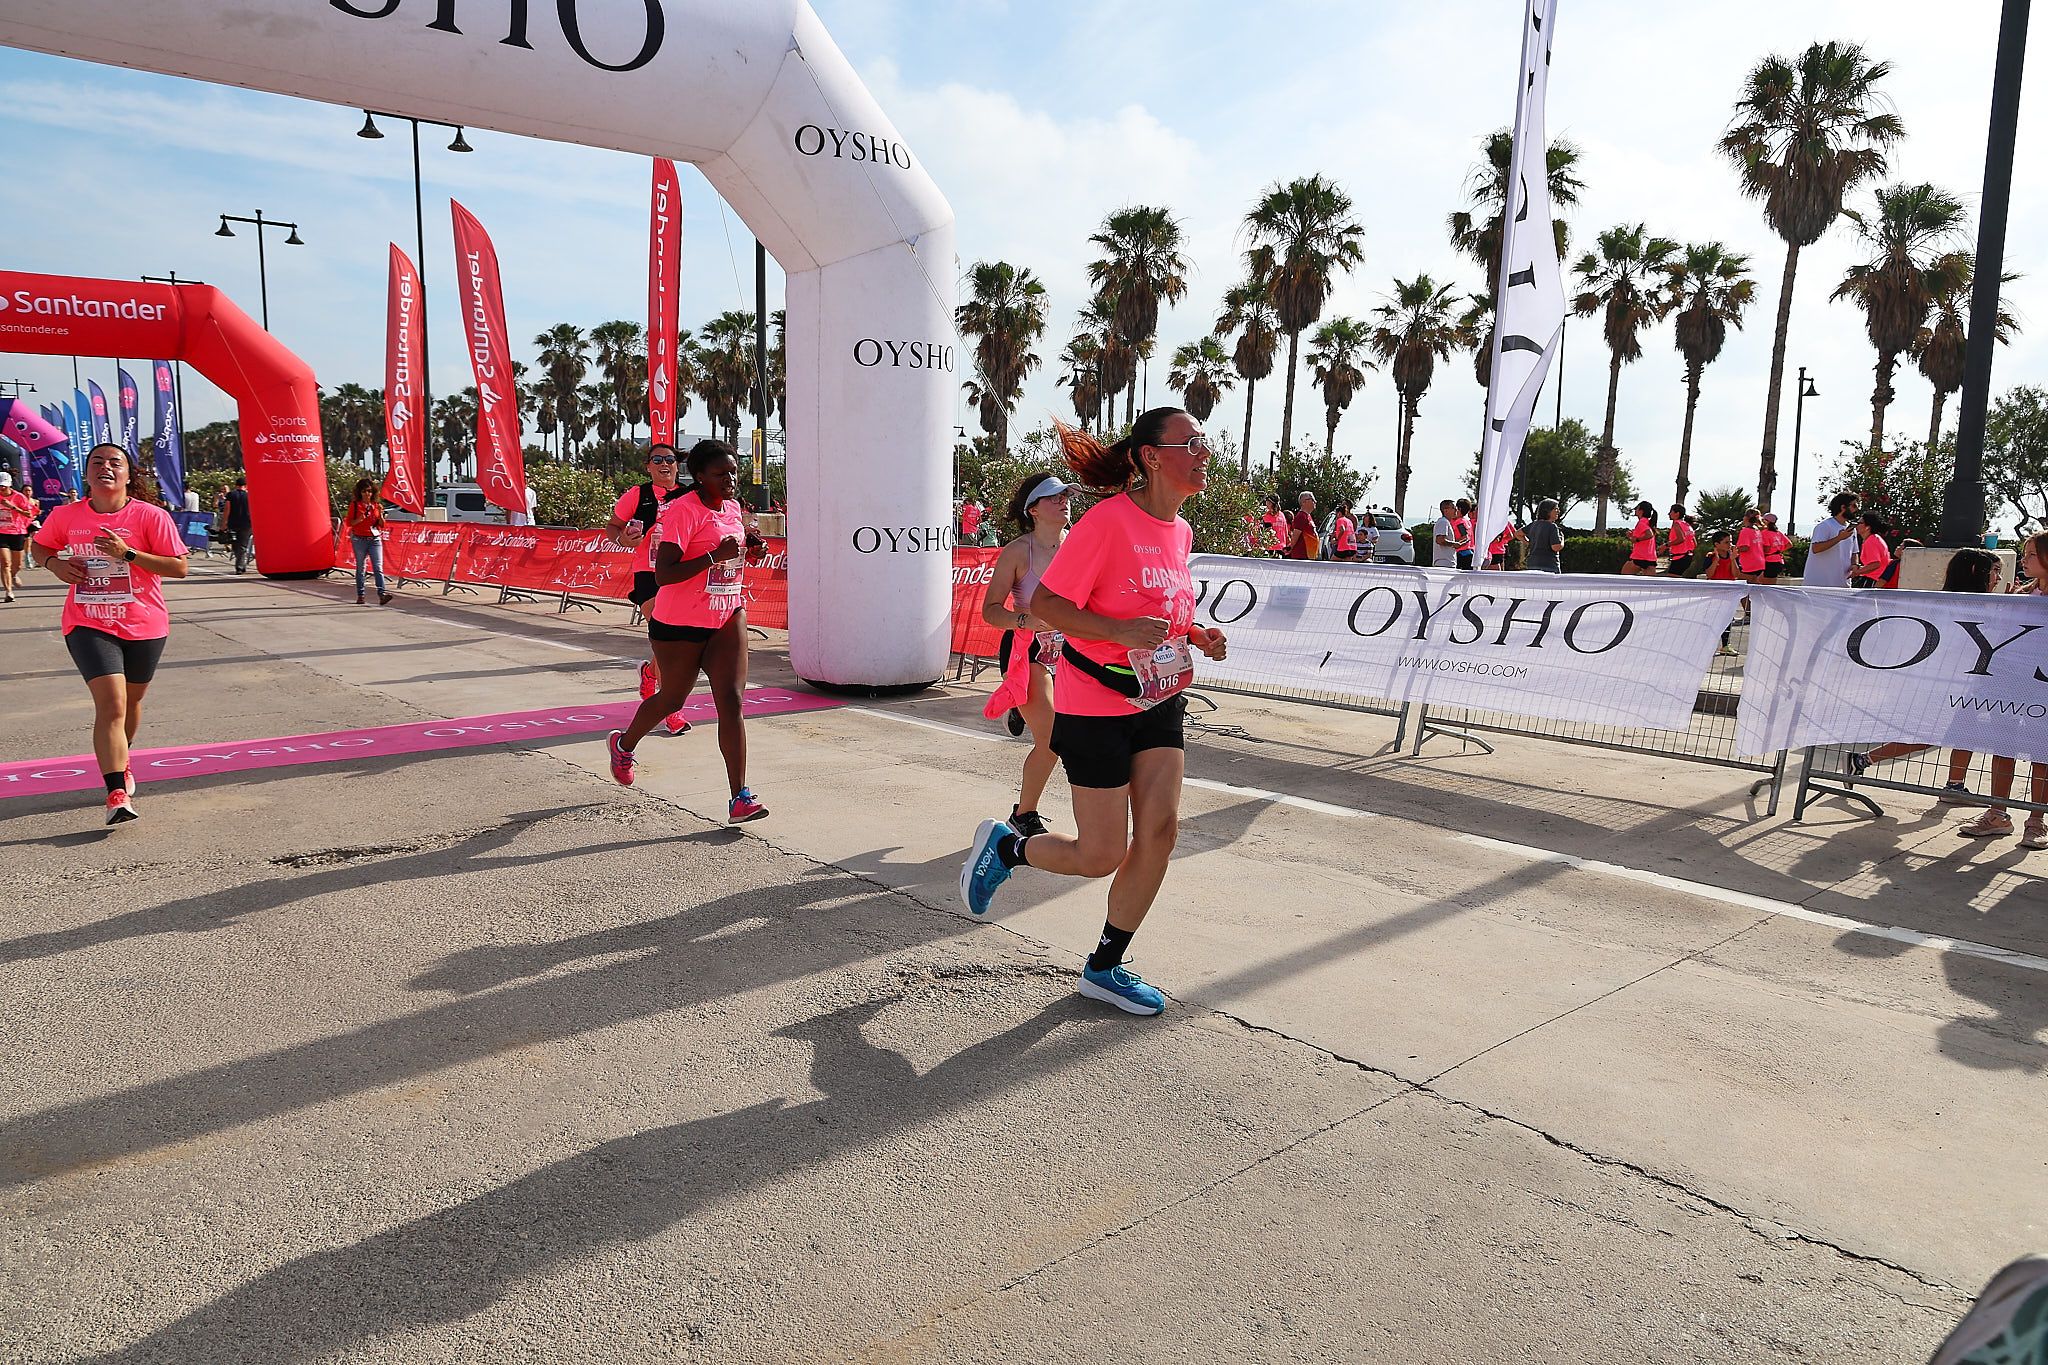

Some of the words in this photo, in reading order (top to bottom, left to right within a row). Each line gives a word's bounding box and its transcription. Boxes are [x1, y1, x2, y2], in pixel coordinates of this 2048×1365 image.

[794, 124, 911, 170] OYSHO
[14, 291, 166, 321] Santander
[853, 338, 954, 373] OYSHO
[270, 415, 307, 427] Sports
[269, 432, 320, 443] Santander
[553, 535, 588, 556] Sports
[1133, 544, 1162, 555] OYSHO
[1347, 586, 1635, 654] OYSHO
[1398, 656, 1528, 679] WWW.OYSHO.COM
[1160, 674, 1180, 690] 016
[423, 713, 606, 738] OYSHO
[150, 738, 375, 768] OYSHO
[975, 847, 995, 877] HOKA
